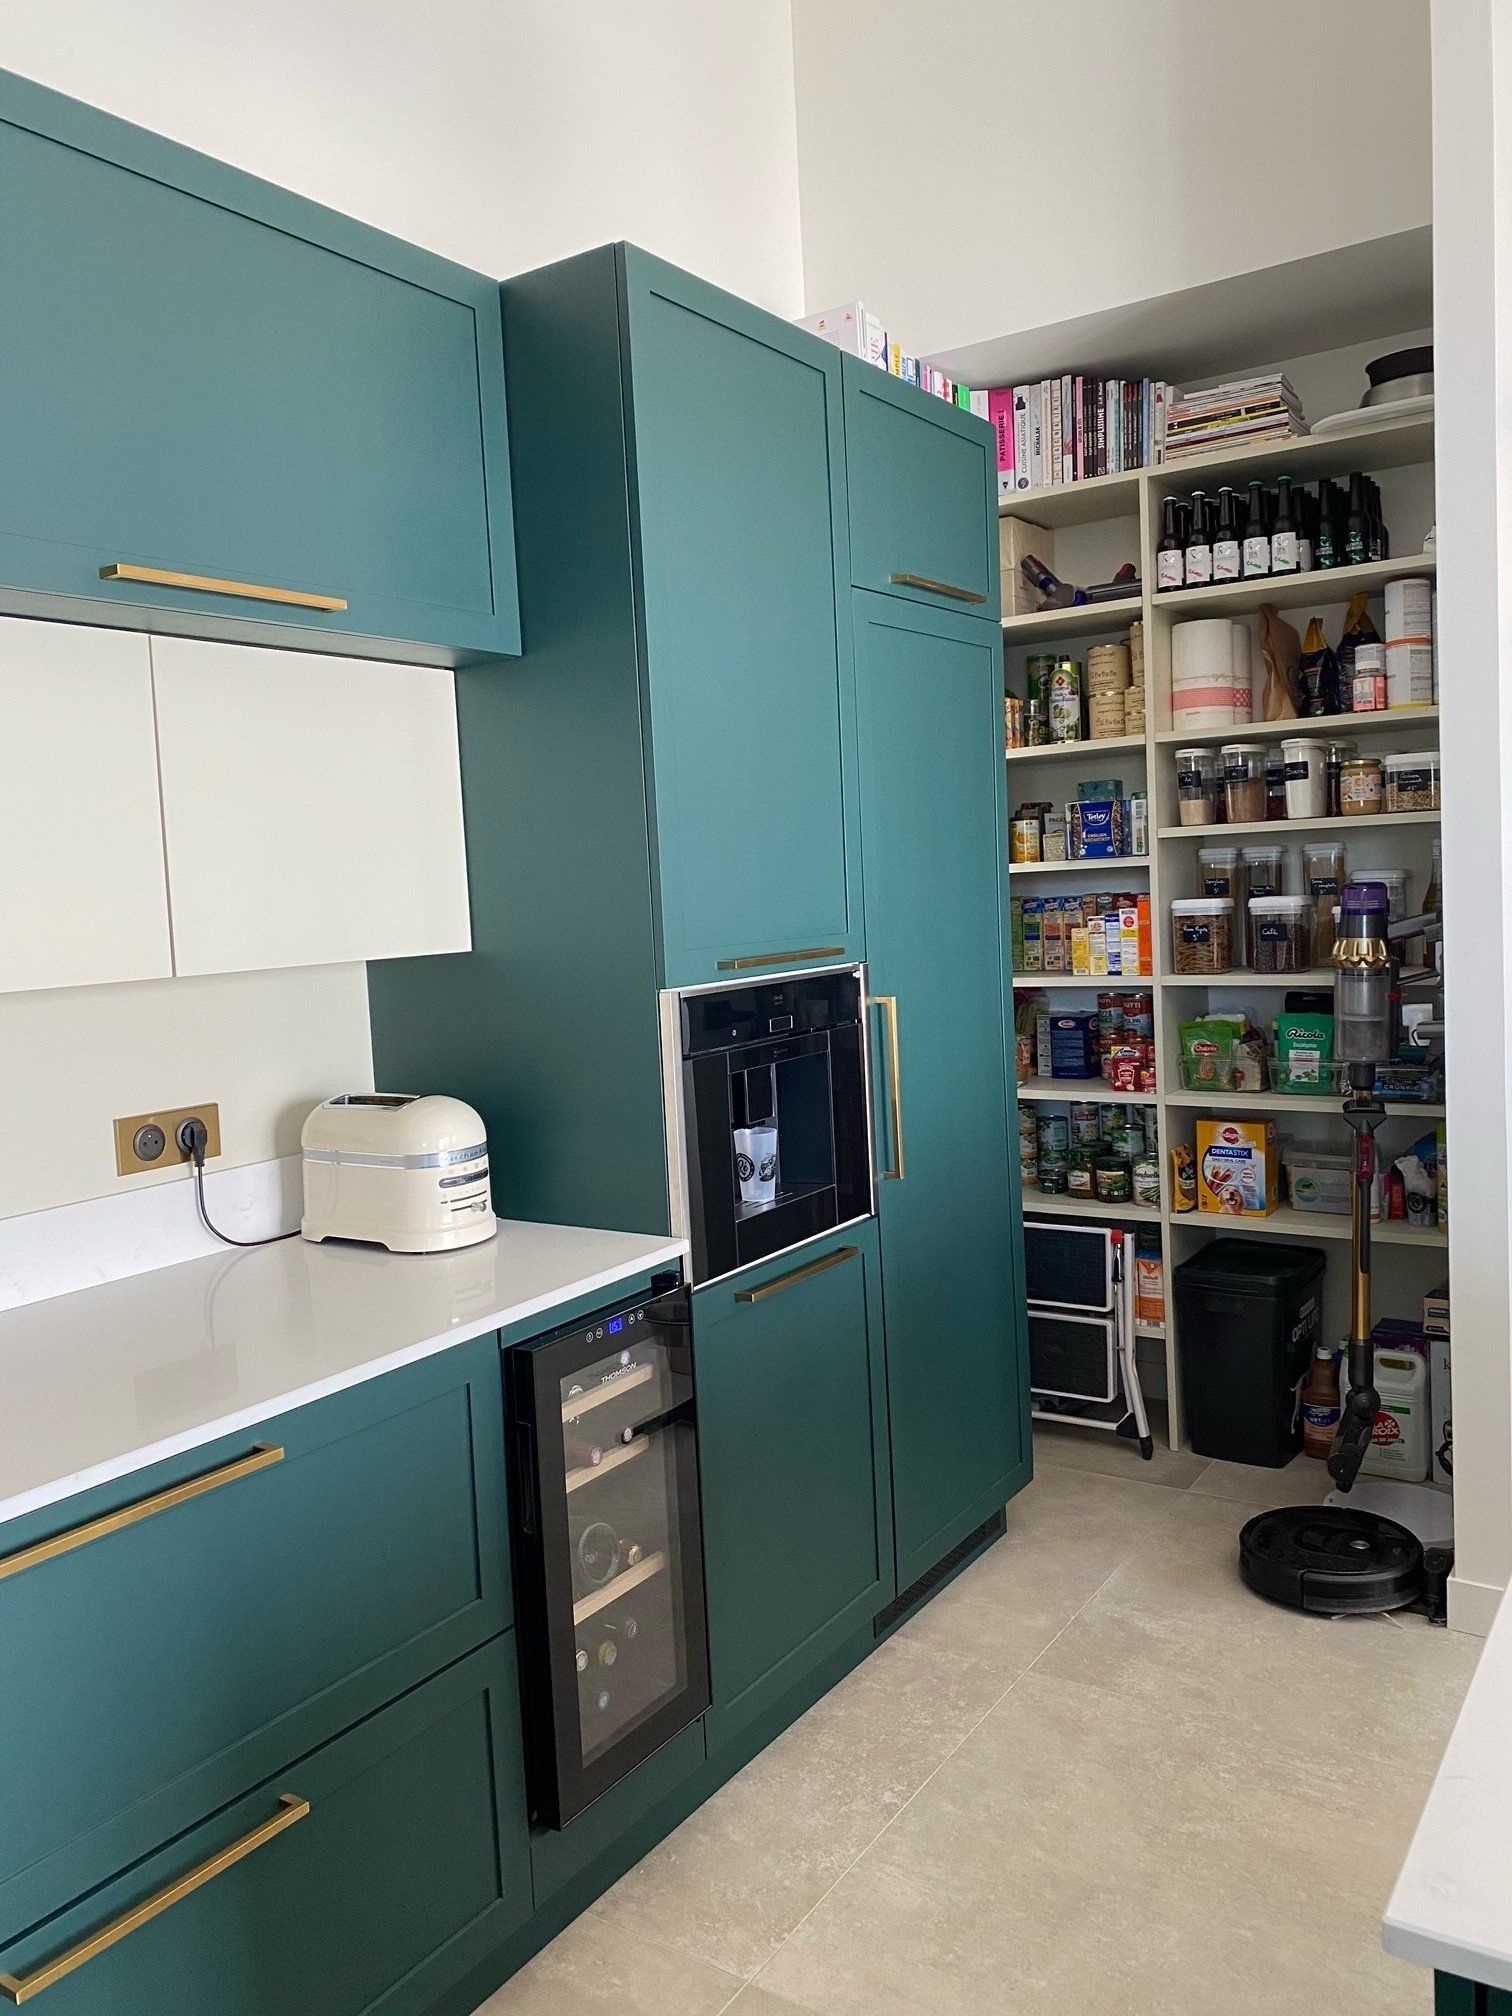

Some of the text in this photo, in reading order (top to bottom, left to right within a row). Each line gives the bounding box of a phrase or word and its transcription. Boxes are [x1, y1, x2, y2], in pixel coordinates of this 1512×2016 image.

[1097, 408, 1105, 449] SIMPLISSIME
[1019, 413, 1028, 474] CUISINE ASIATIQUE
[1285, 767, 1307, 776] Sucre
[1086, 812, 1106, 822] Tetley
[1286, 1028, 1325, 1040] Ricola
[1211, 1148, 1250, 1157] DENTASTIX
[601, 1361, 637, 1385] THOMSON
